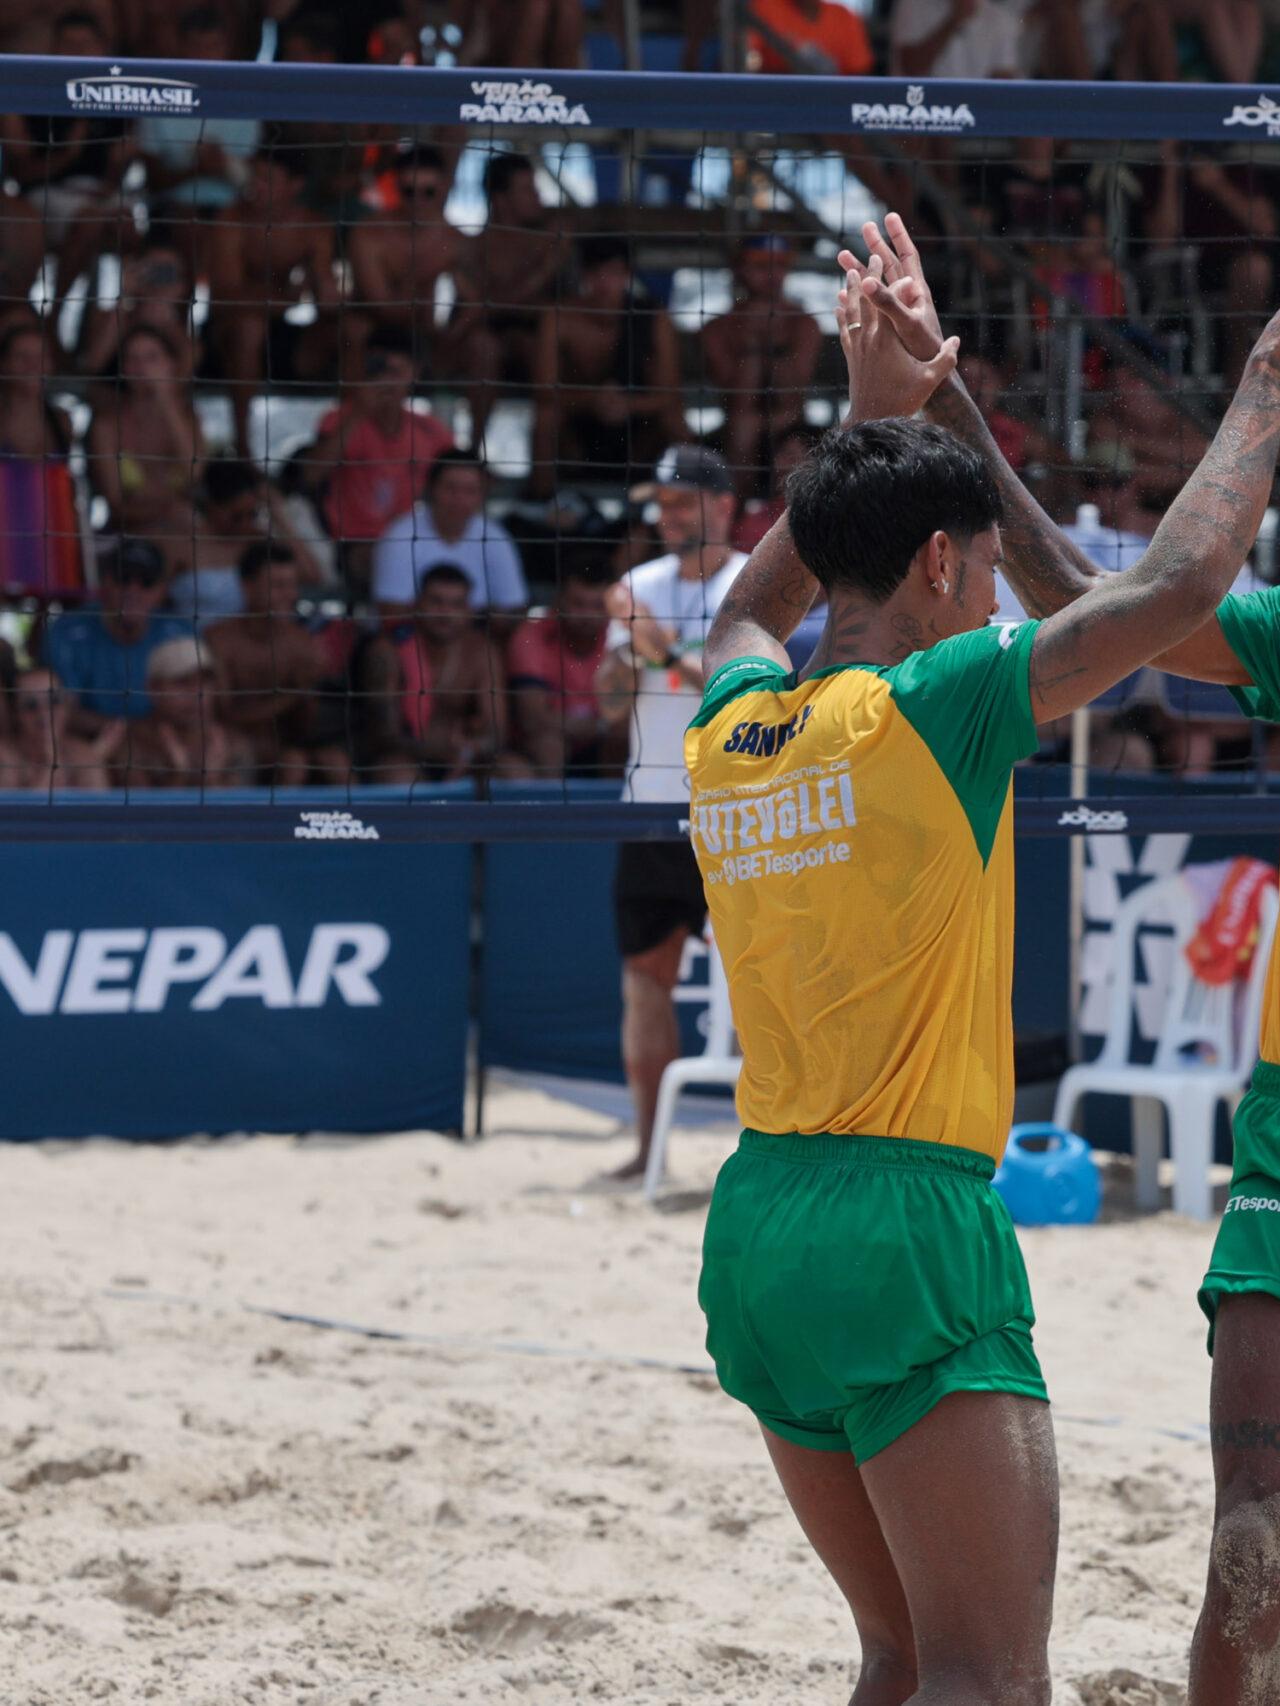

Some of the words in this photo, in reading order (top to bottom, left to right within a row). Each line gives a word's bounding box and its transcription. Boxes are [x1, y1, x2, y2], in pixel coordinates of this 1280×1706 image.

[460, 103, 591, 125] PARANÁ
[851, 103, 975, 127] PARANÁ
[735, 842, 851, 882] BETesporte
